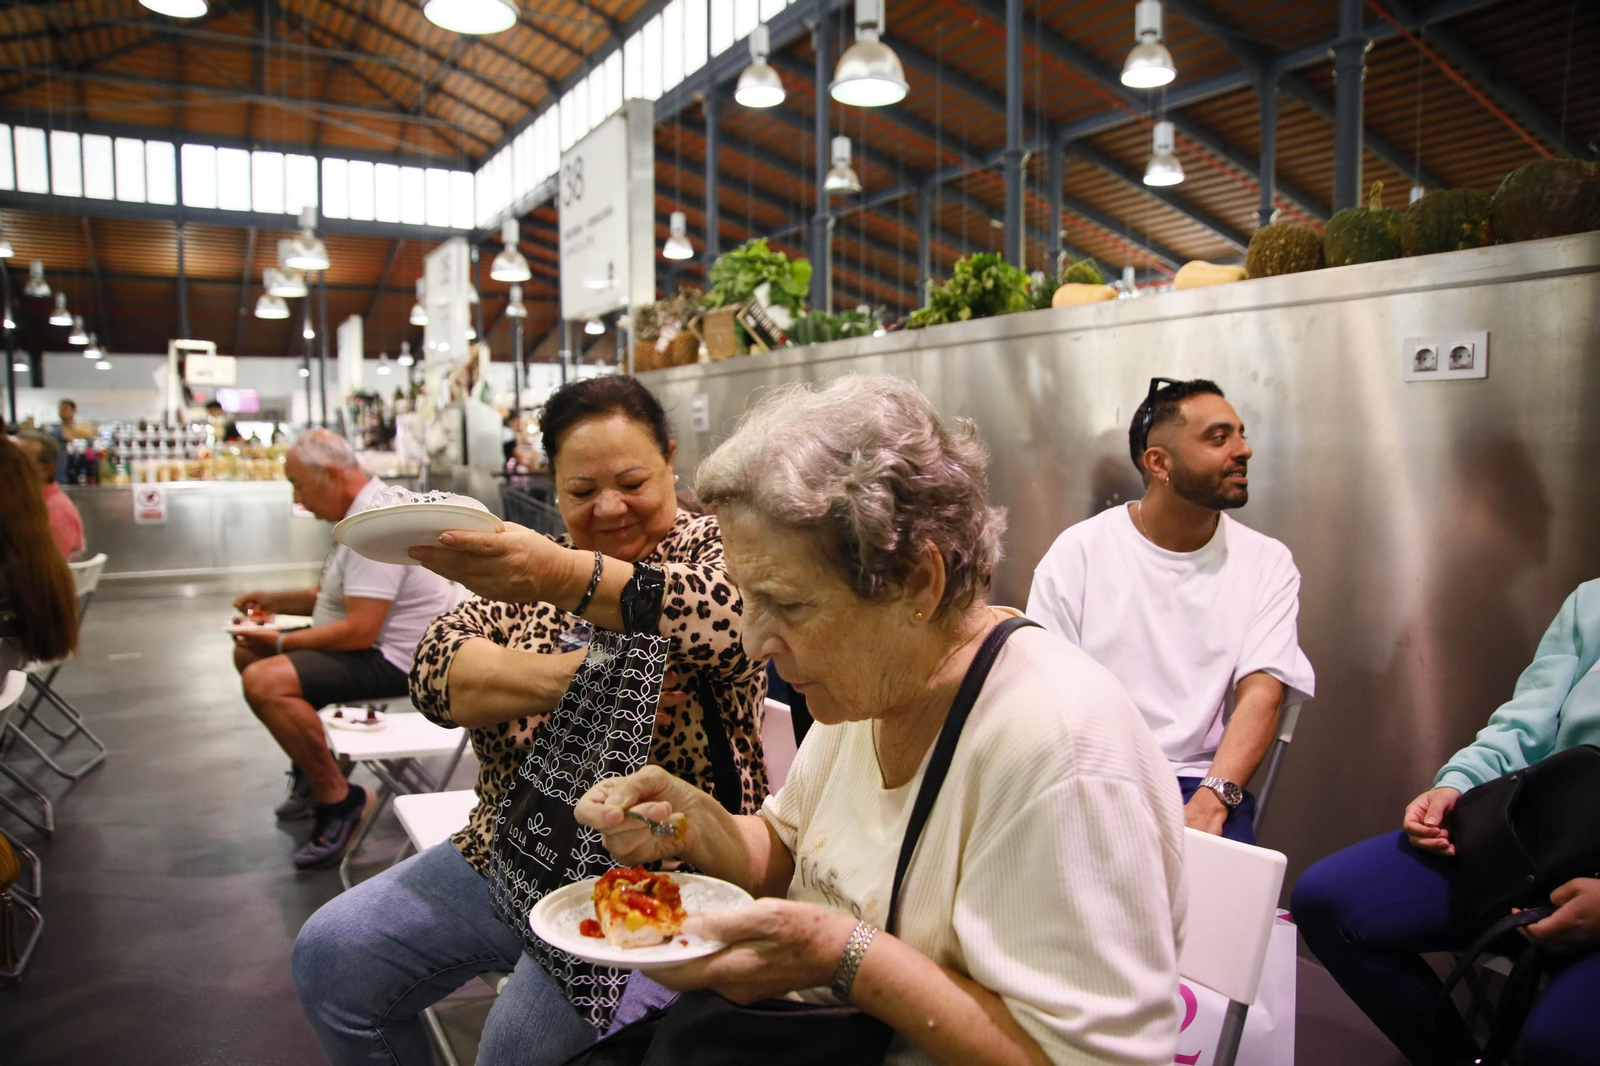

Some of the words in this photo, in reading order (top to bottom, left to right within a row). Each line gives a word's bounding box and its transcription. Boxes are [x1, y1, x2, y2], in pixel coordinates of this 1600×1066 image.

[562, 156, 584, 207] 38
[508, 823, 528, 847] LOLA
[534, 841, 559, 865] RUIZ
